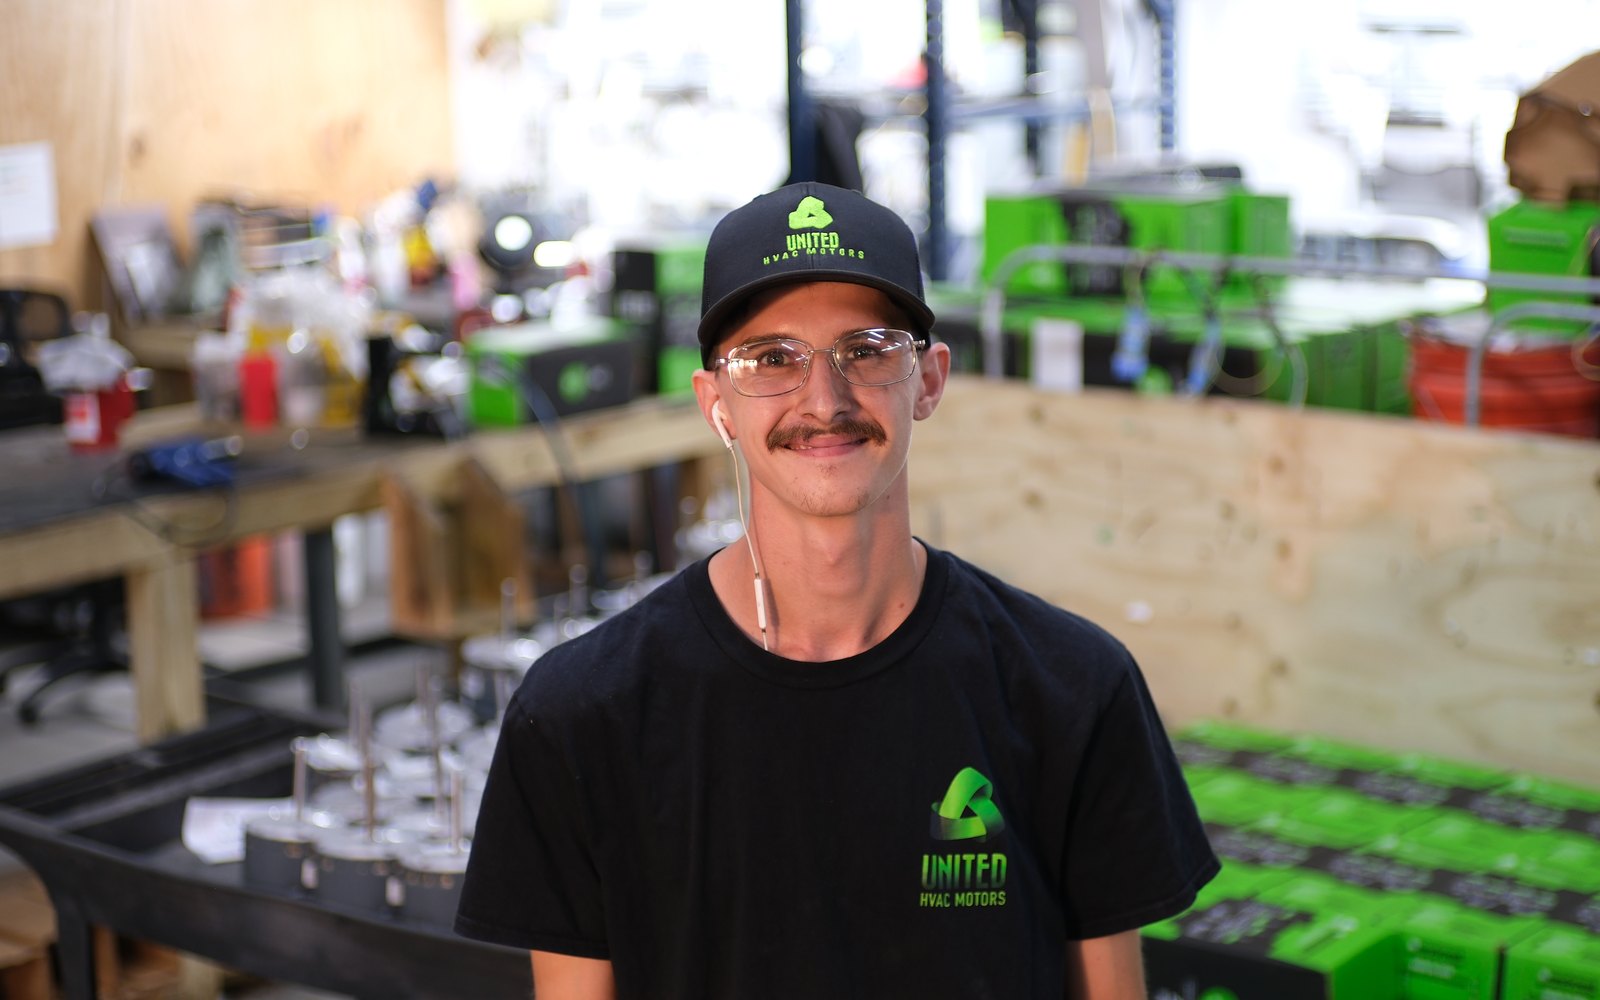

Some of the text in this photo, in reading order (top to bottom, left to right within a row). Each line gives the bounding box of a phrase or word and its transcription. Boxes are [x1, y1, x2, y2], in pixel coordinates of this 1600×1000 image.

[786, 231, 839, 251] UNITED
[763, 247, 865, 265] HVAC MOTORS
[921, 853, 1007, 890] UNITED
[920, 891, 1007, 908] HVAC MOTORS
